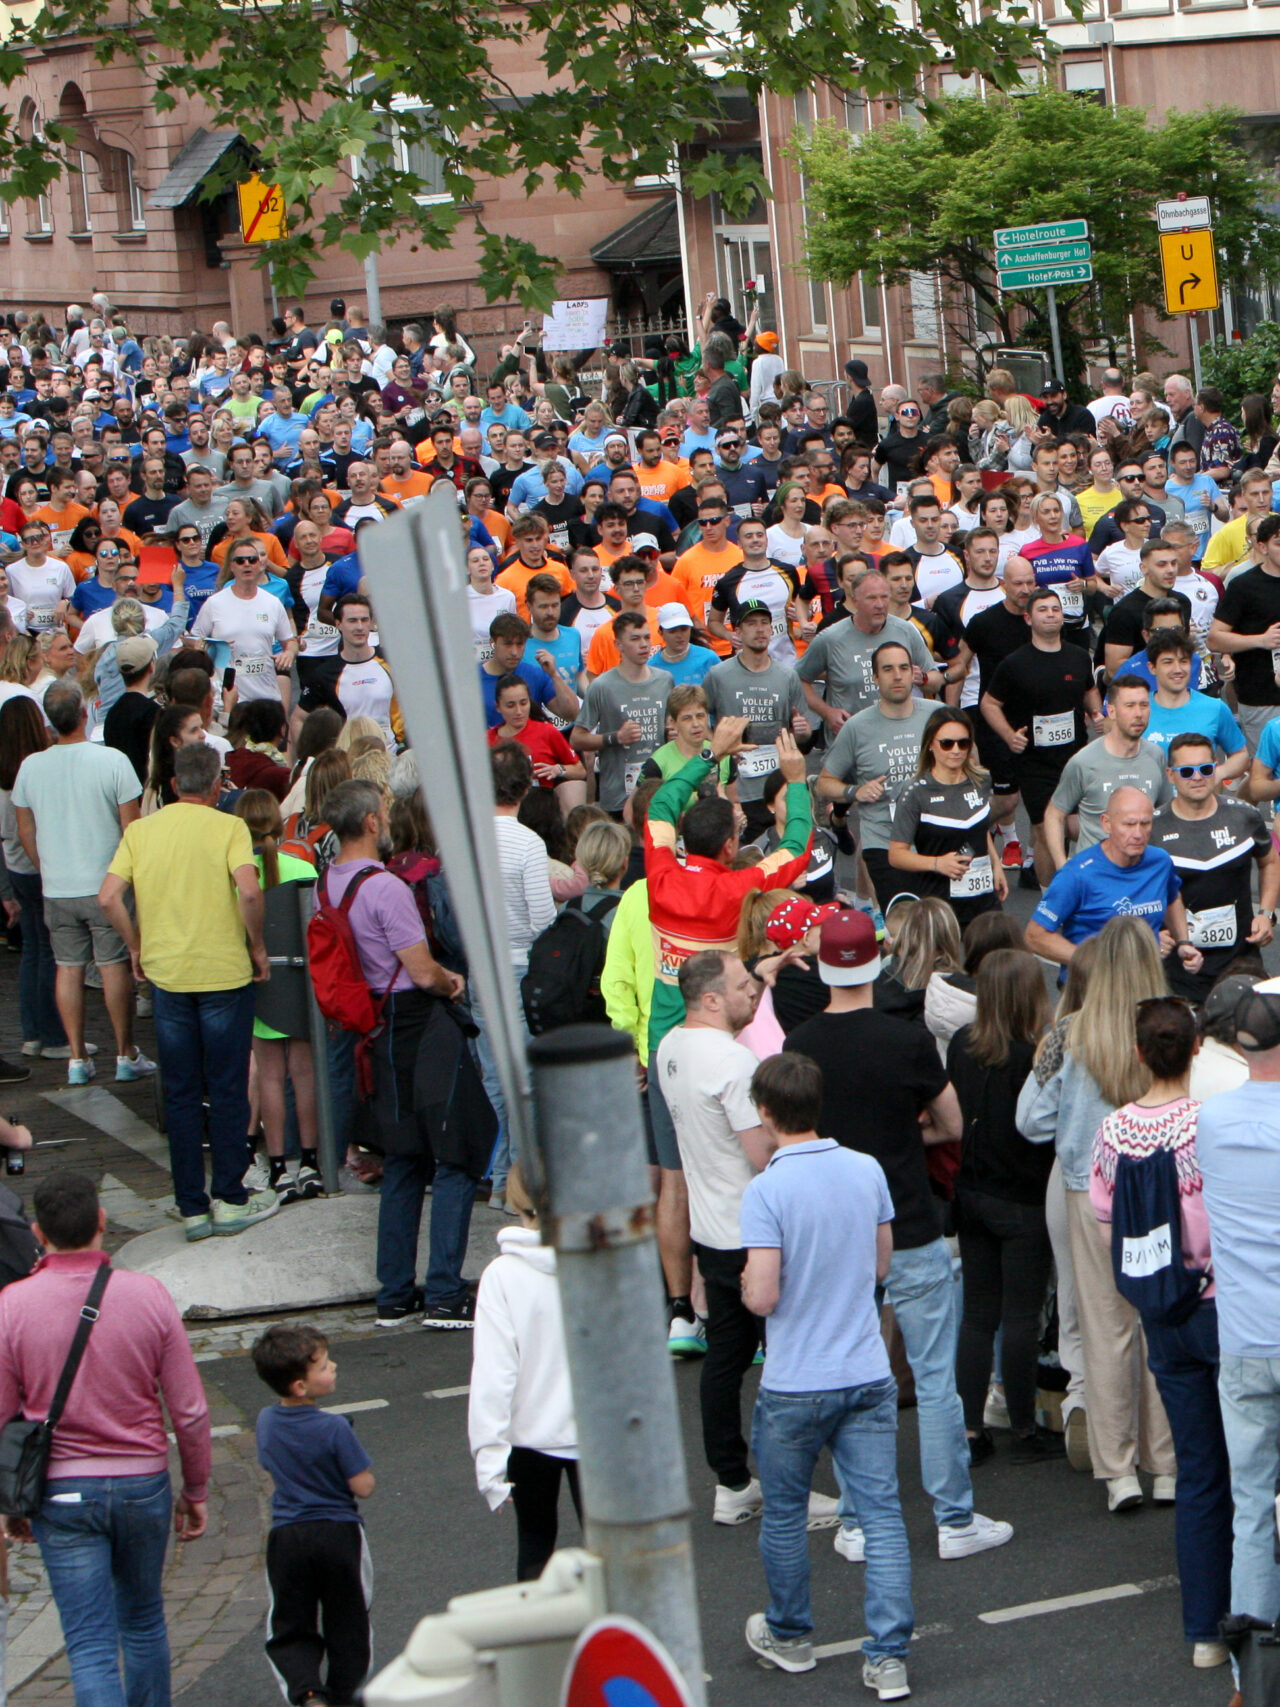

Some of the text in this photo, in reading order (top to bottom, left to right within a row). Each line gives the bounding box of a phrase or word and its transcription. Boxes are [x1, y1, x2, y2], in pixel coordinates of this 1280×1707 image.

[259, 197, 279, 214] U2
[1161, 206, 1207, 221] Ohmbachgasse
[1012, 227, 1066, 243] Hotelroute
[1014, 248, 1087, 263] Aschaffenburger Hof
[1180, 244, 1194, 261] U
[1054, 269, 1075, 279] Post
[1033, 558, 1047, 567] FVB
[1054, 557, 1066, 565] We
[1036, 563, 1076, 574] Rhein/Main
[1062, 595, 1079, 606] 3189
[245, 663, 264, 674] 3257
[742, 698, 774, 706] VOLLER
[626, 708, 658, 717] VOLLER
[742, 706, 774, 715] BEWE
[1048, 729, 1072, 742] 3556
[752, 758, 777, 773] 3570
[963, 789, 979, 801] uni
[969, 799, 984, 810] per
[1162, 832, 1179, 842] JAKO
[1210, 827, 1229, 840] uni
[1217, 836, 1237, 849] per
[968, 875, 991, 891] 3815
[1201, 927, 1234, 943] 3820
